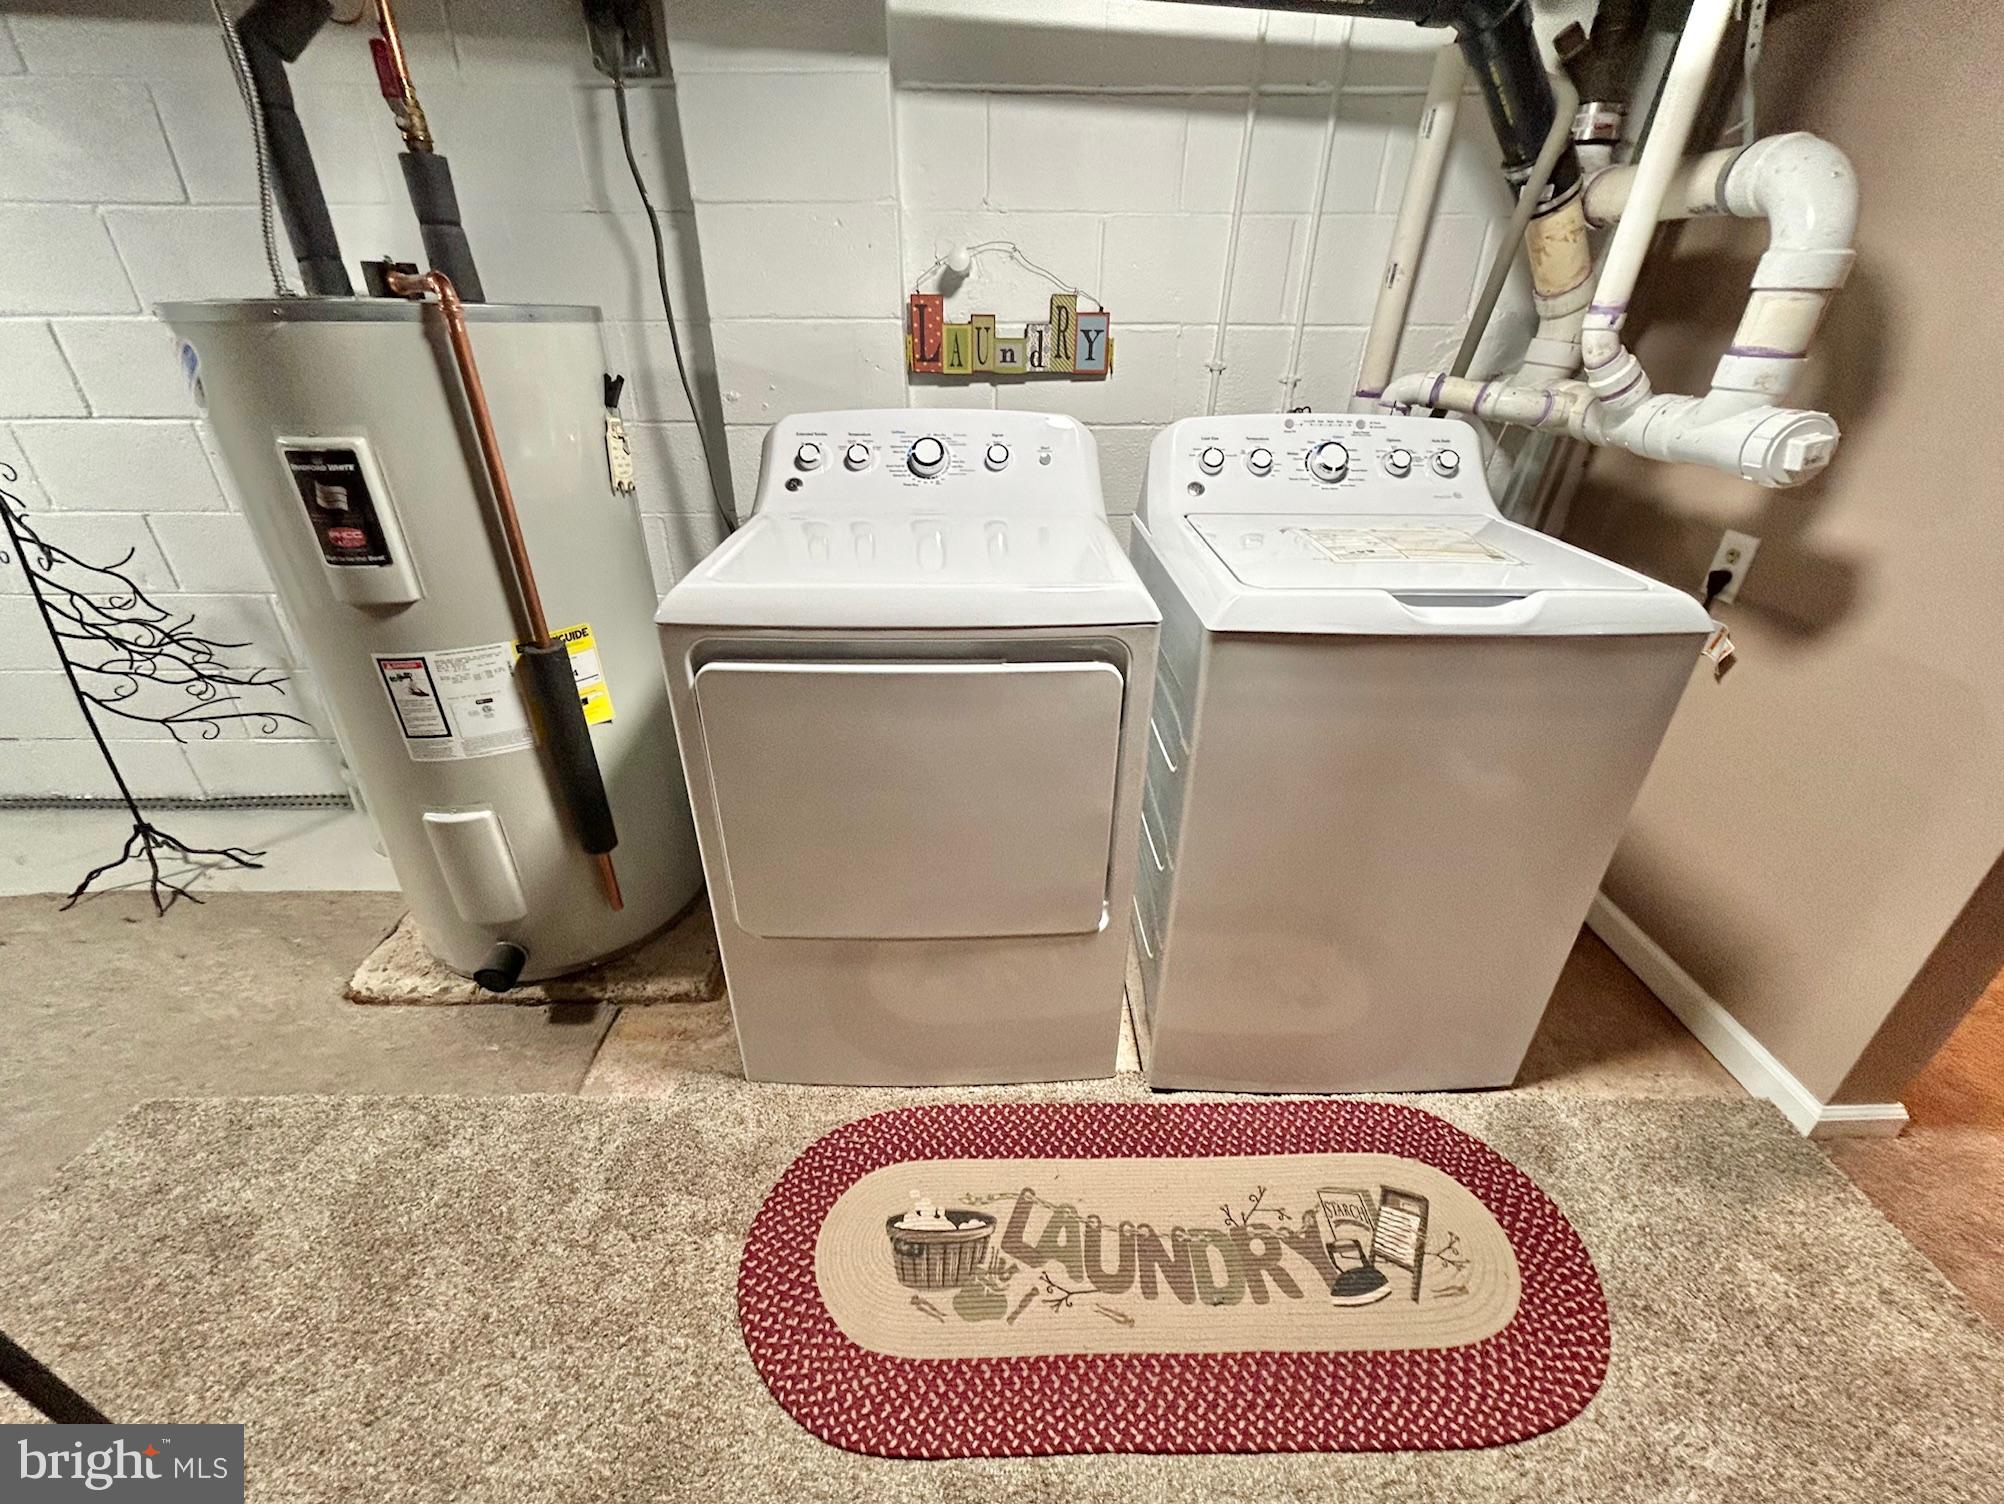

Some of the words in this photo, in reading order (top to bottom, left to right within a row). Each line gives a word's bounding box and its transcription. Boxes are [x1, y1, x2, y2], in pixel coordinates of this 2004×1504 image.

[328, 463, 355, 471] WHITE
[1323, 1201, 1371, 1225] STARCH
[1000, 1187, 1340, 1305] LAUNDRY
